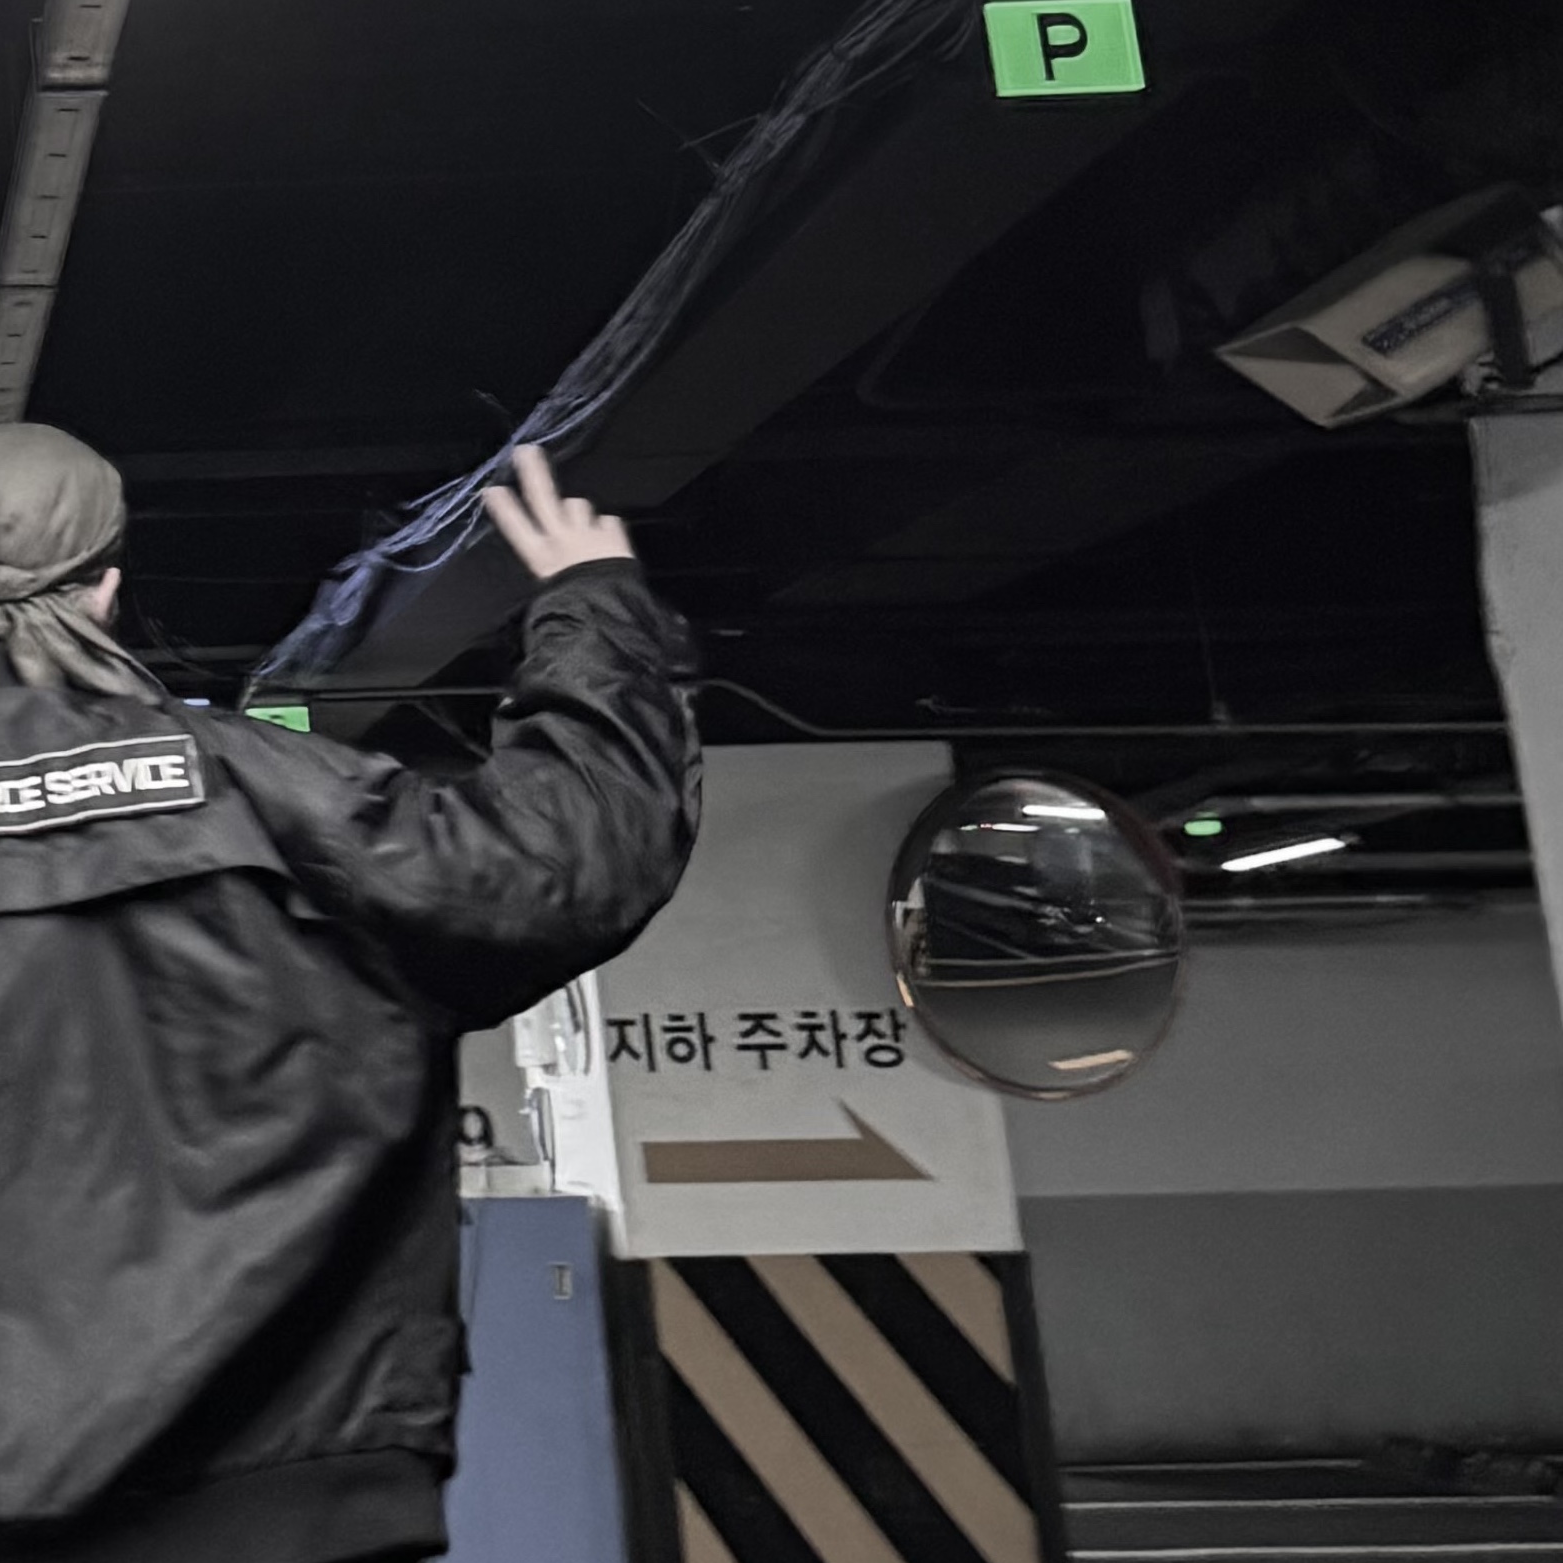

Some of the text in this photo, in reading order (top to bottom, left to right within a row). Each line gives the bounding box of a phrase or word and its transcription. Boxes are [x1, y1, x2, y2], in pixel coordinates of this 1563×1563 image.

[1035, 12, 1088, 82] P
[45, 754, 190, 805] SERVICE
[605, 1007, 907, 1073] 지하 주차장
